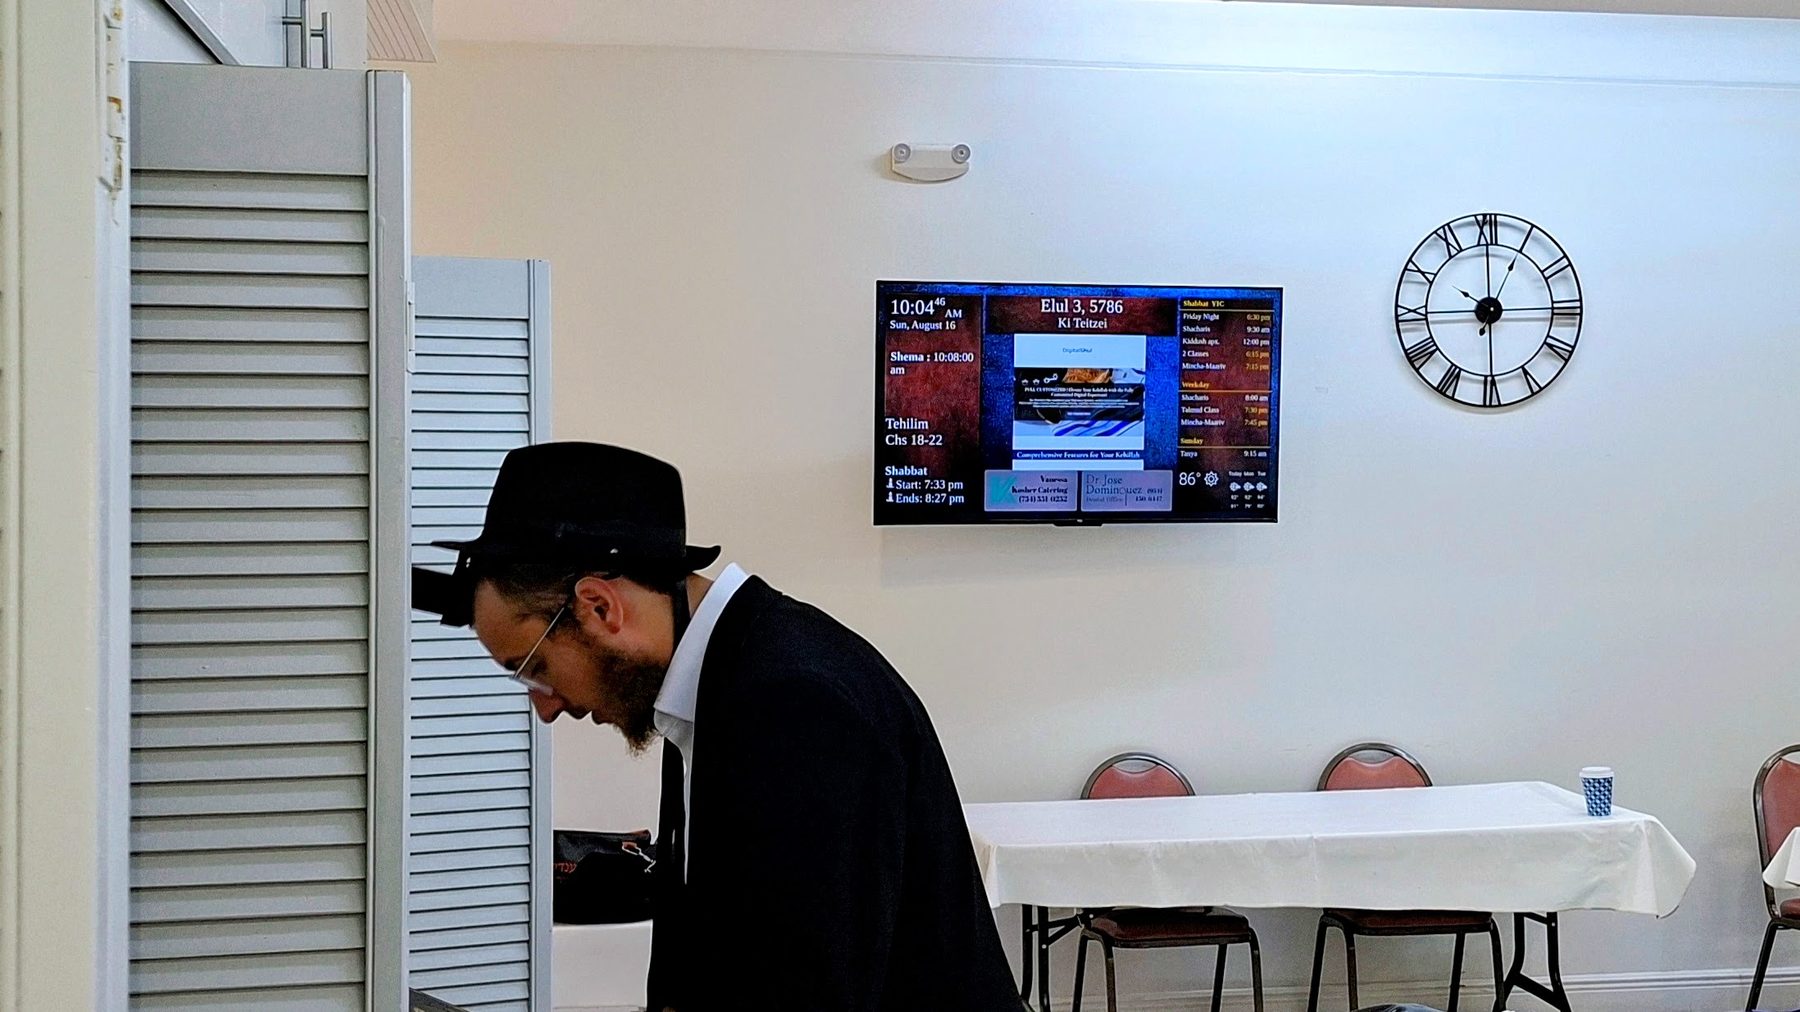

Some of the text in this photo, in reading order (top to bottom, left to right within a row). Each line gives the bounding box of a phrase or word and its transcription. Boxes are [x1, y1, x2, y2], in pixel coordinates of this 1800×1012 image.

[891, 297, 962, 318] 10:04 46 AM
[1040, 298, 1124, 315] Elul 3, 5786
[1183, 300, 1209, 308] Shabbat
[1057, 317, 1071, 329] Ki
[1183, 313, 1220, 322] Friday Night
[889, 320, 956, 332] Sun, August 16
[1246, 326, 1260, 334] 9:30
[1243, 338, 1260, 346] 12:00
[890, 351, 925, 362] Shema
[933, 352, 974, 362] 10:08:00
[889, 366, 905, 375] am
[1181, 381, 1210, 390] Weekday
[885, 418, 929, 430] Tehilim
[885, 434, 944, 446] Chs 18-22
[1089, 450, 1100, 459] for
[1100, 450, 1115, 458] Your
[884, 465, 928, 476] Shabbat
[1179, 471, 1202, 486] 86°
[895, 480, 964, 493] Start: 7:33 pm
[895, 493, 965, 506] Ends: 8:27 pm
